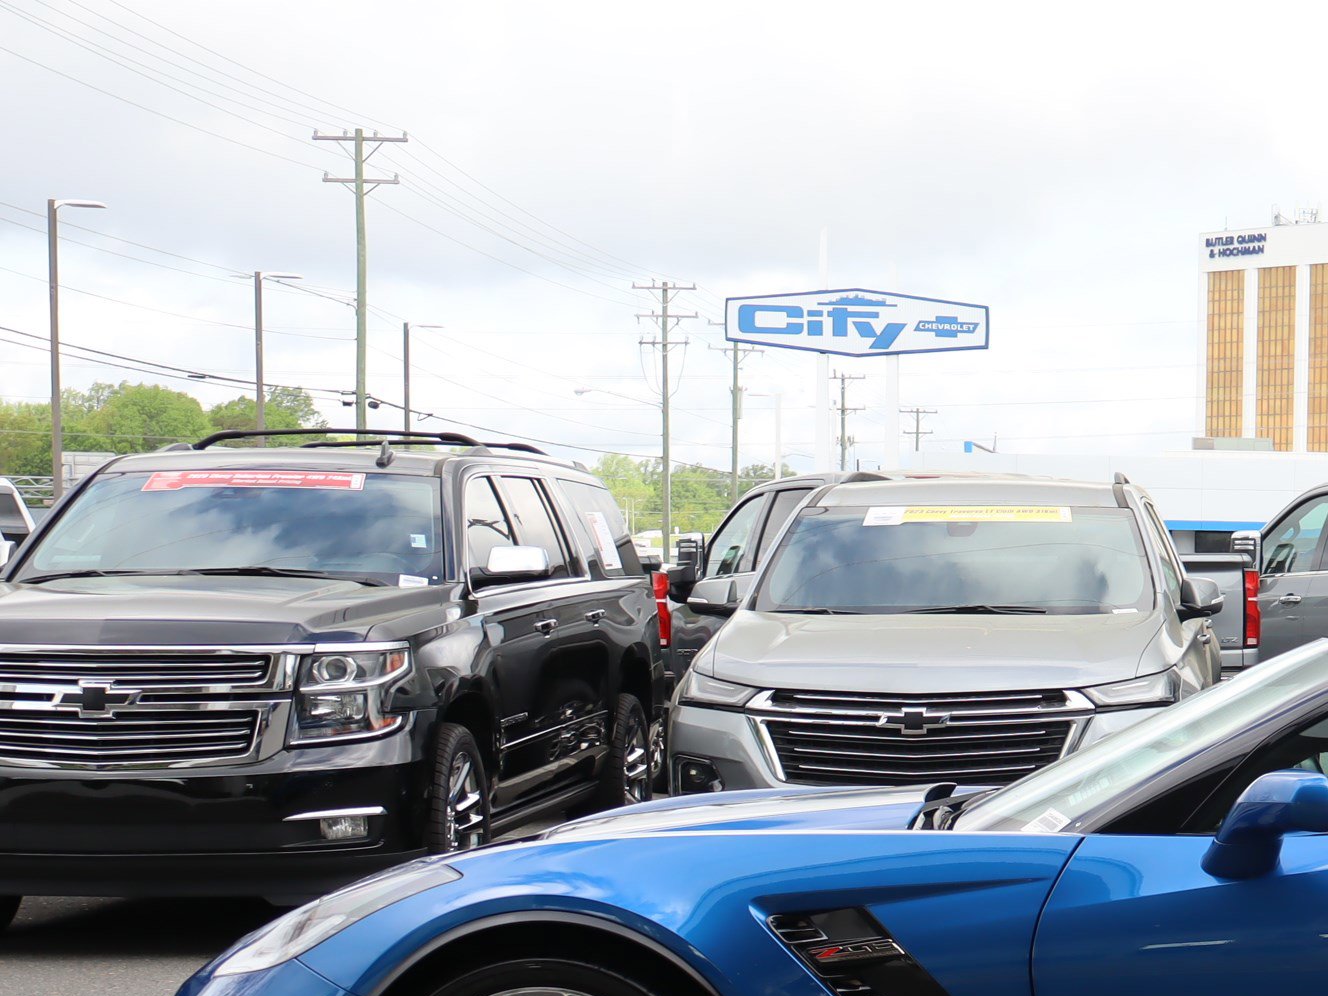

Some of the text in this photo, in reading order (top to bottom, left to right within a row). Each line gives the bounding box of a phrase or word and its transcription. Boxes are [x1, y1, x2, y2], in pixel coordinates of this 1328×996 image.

[1205, 233, 1267, 247] BUTLER QUINN
[1209, 245, 1265, 258] & HOCHMAN
[738, 304, 908, 349] City
[919, 321, 975, 332] CHEVROLET
